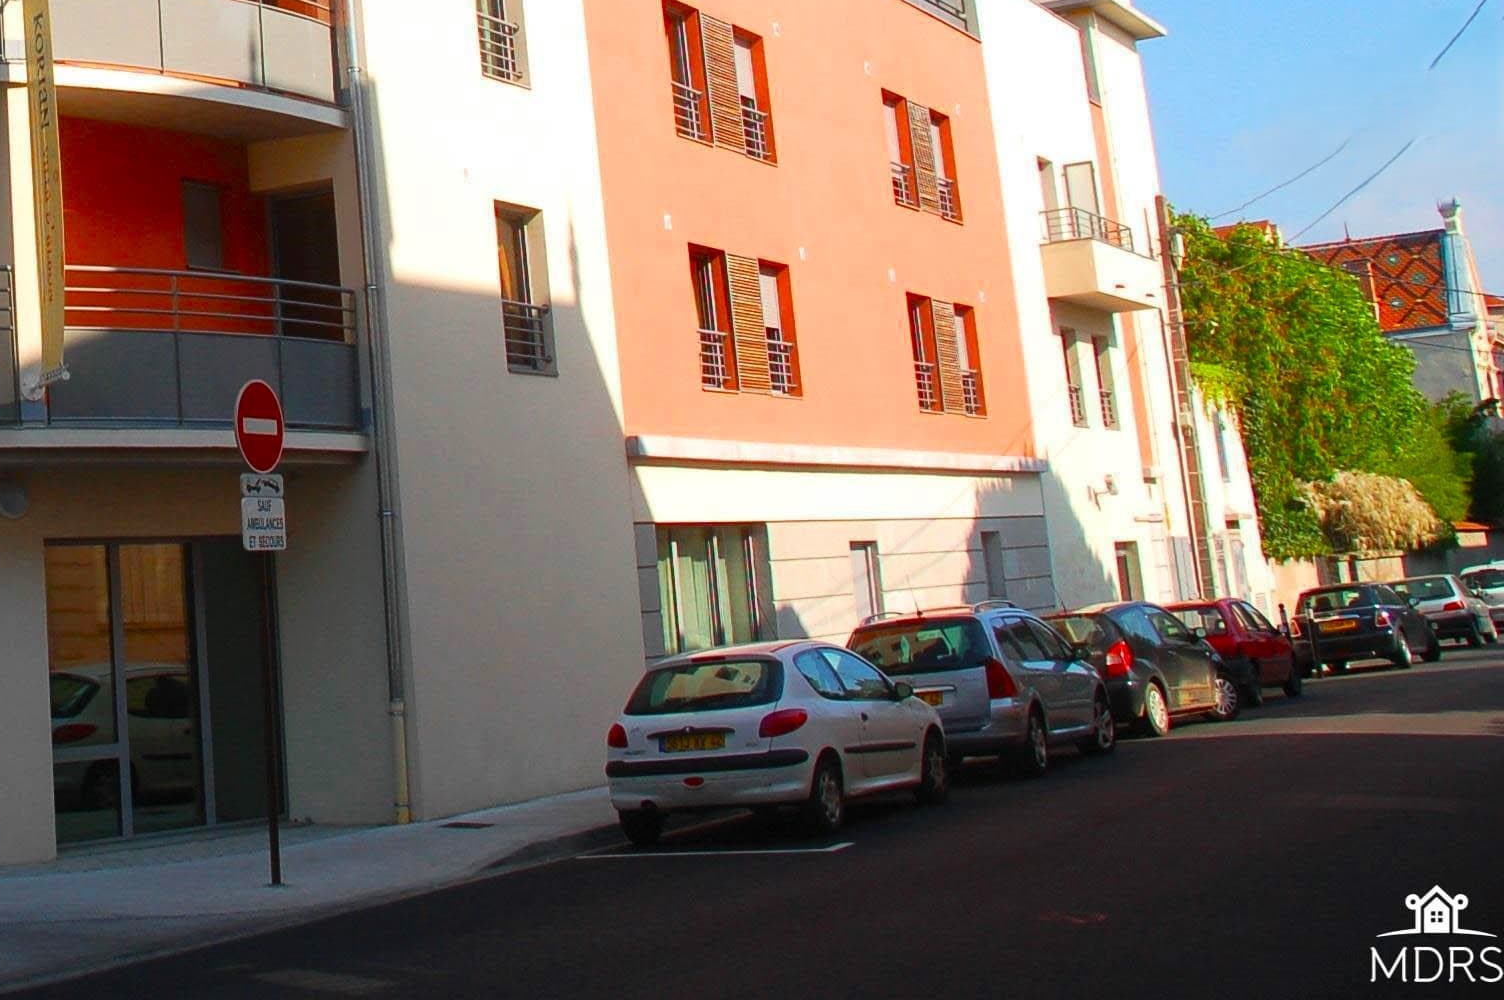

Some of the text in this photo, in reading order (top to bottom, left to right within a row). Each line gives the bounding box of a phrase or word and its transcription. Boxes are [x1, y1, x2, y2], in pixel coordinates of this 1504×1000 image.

[257, 499, 272, 512] SAUF
[247, 517, 284, 530] AMBULANCES
[258, 535, 284, 548] SECOURS
